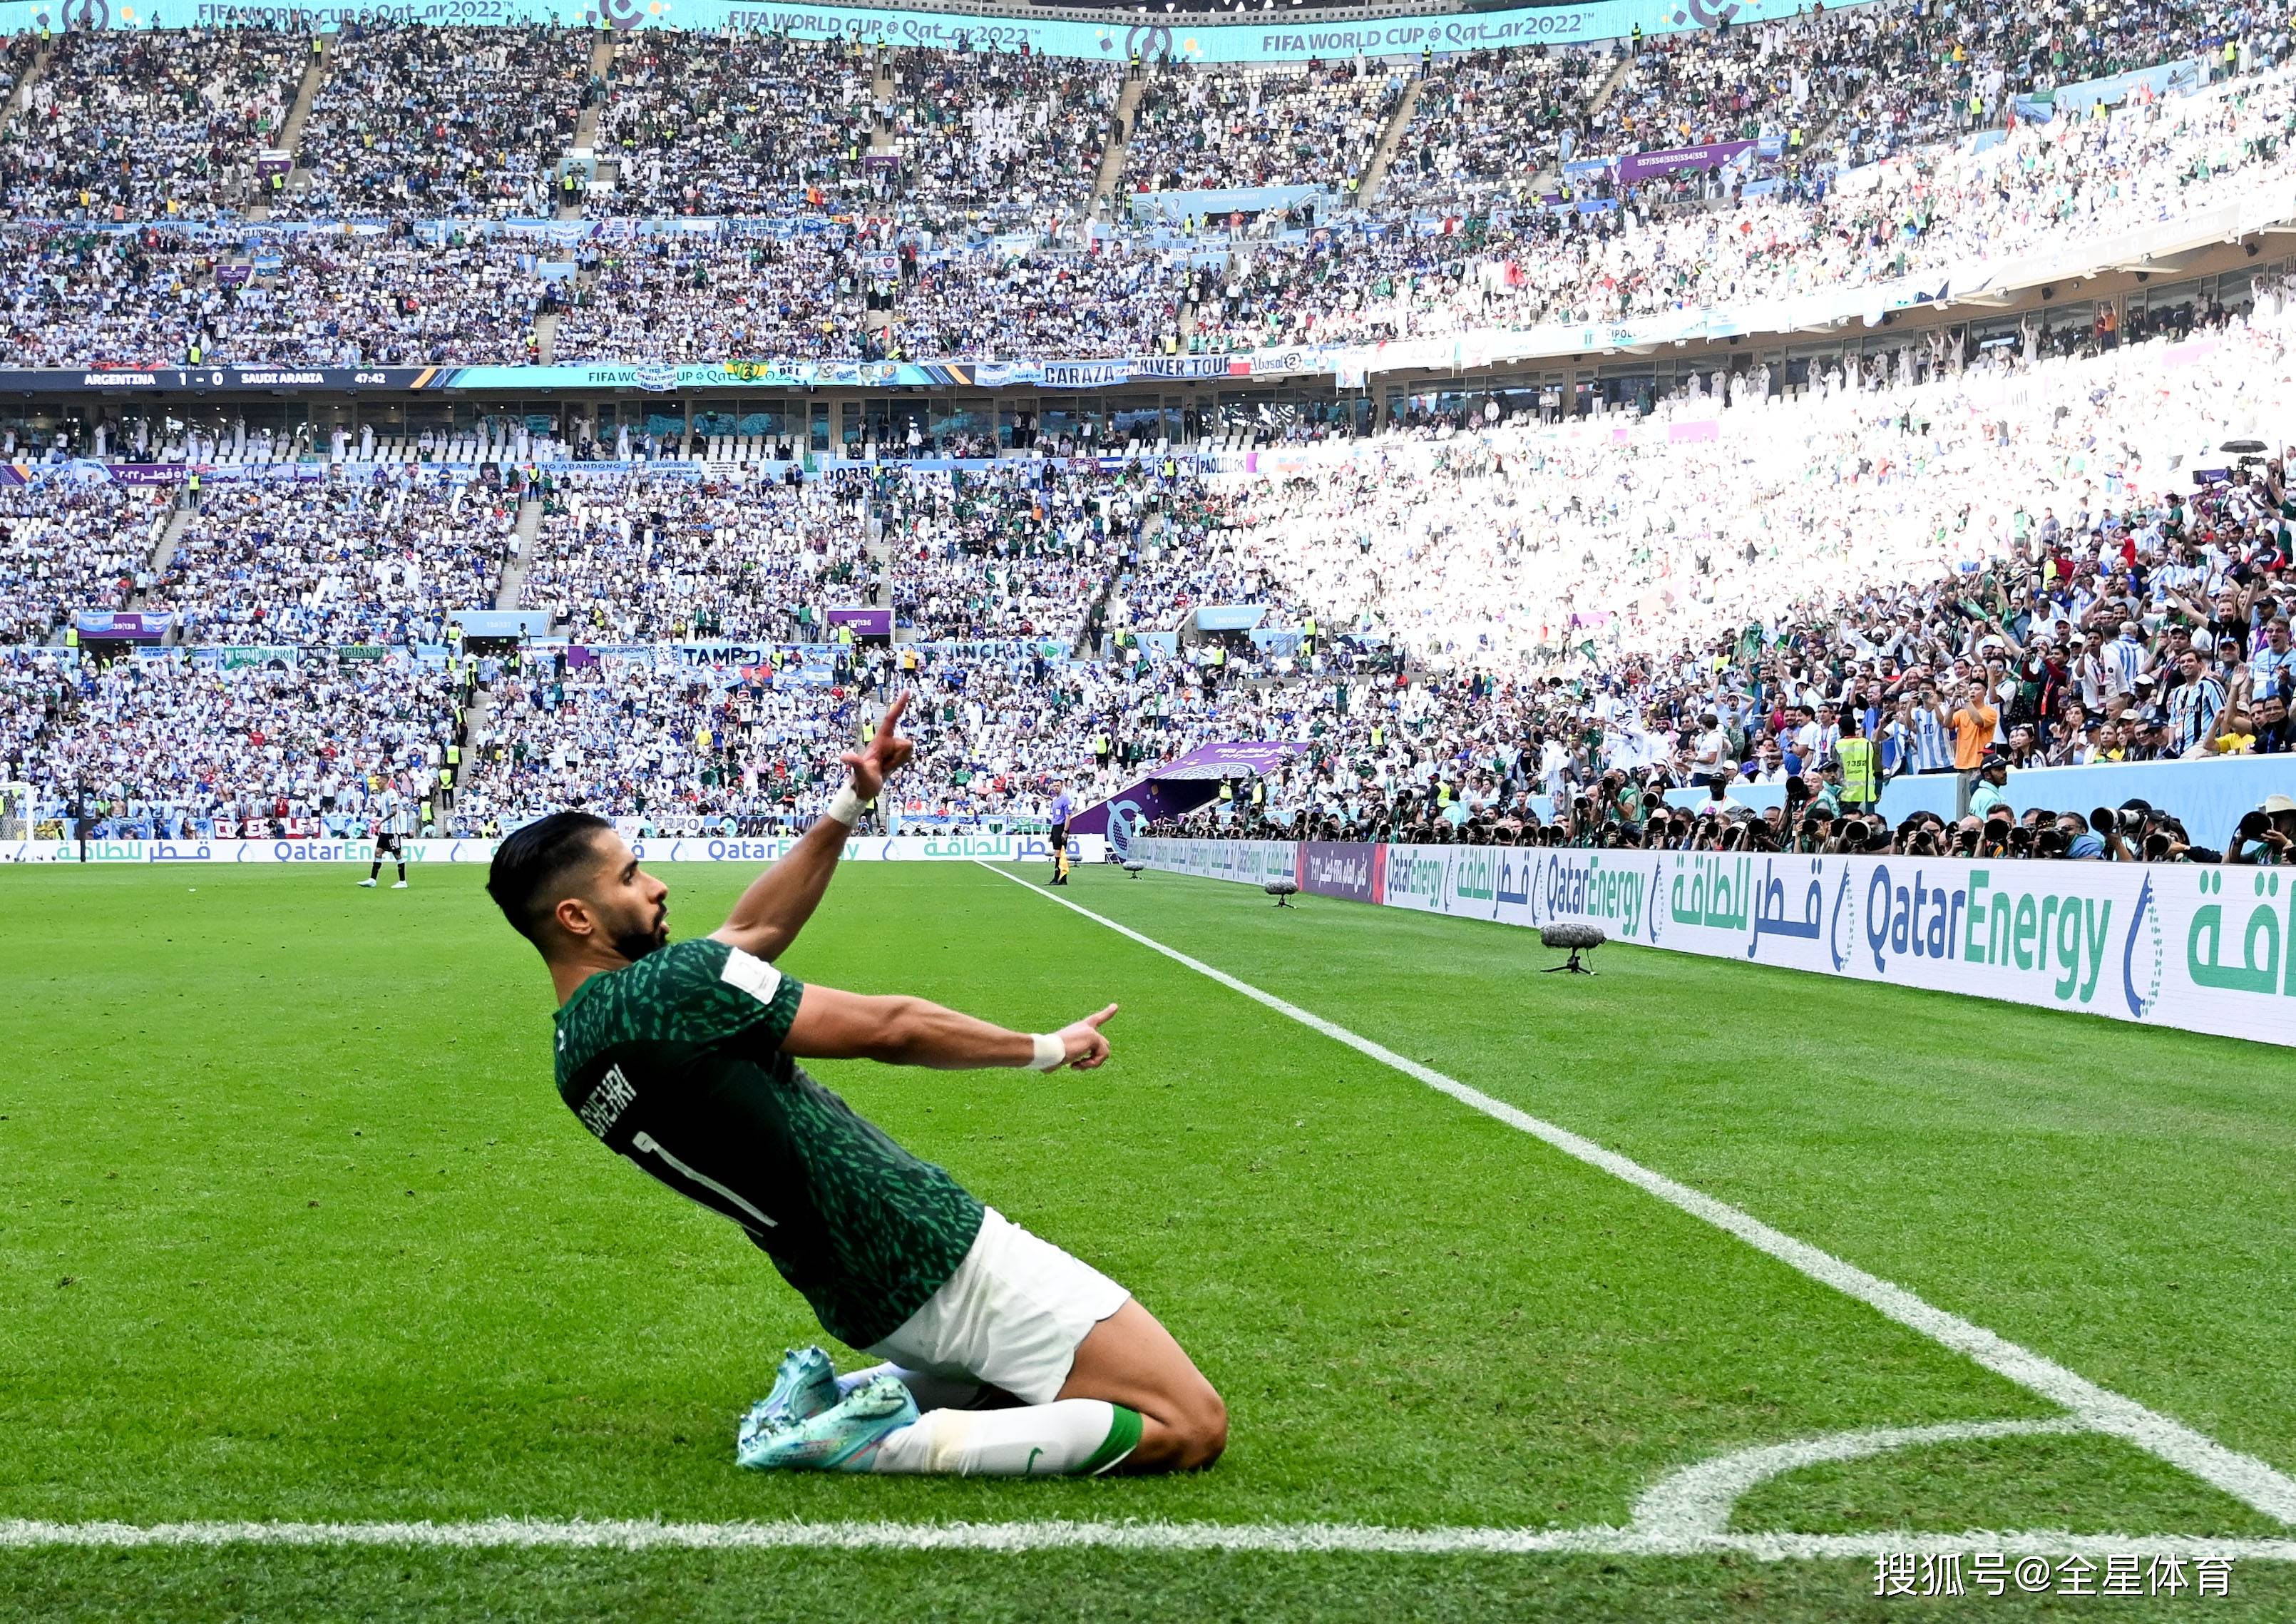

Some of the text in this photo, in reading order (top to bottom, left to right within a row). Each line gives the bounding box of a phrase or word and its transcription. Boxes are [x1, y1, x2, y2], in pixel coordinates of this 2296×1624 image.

[319, 9, 354, 24] CUP
[729, 11, 769, 28] FIFA
[773, 13, 842, 33] WORLD
[846, 19, 883, 35] CUP
[1263, 35, 1305, 52] FIFA
[1308, 30, 1380, 50] WORLD
[1386, 27, 1424, 46] CUP
[589, 372, 616, 382] FIFA
[677, 372, 692, 382] UP
[1045, 362, 1115, 382] CARAZA
[1139, 358, 1185, 377] RIVER
[84, 374, 156, 386] ARGENTINA
[180, 374, 187, 386] 1
[212, 374, 224, 386] 0
[241, 374, 277, 384] SAUDI
[280, 373, 324, 384] ARABIA
[354, 373, 386, 384] 47:42
[339, 648, 384, 657] AGUANTE
[1923, 724, 1934, 734] 10
[150, 840, 211, 863] قطر
[274, 841, 427, 863] QatarEngy
[708, 840, 860, 862] QatarEy
[924, 836, 1010, 857] للطاقة
[1388, 848, 1444, 908] QatarEnergy
[1457, 848, 1529, 919] قطر للطاقة
[1547, 854, 1645, 937] QatarEnergy
[1671, 854, 1822, 958] قطر للطاقة
[1866, 863, 2112, 1003] QatarEnergy
